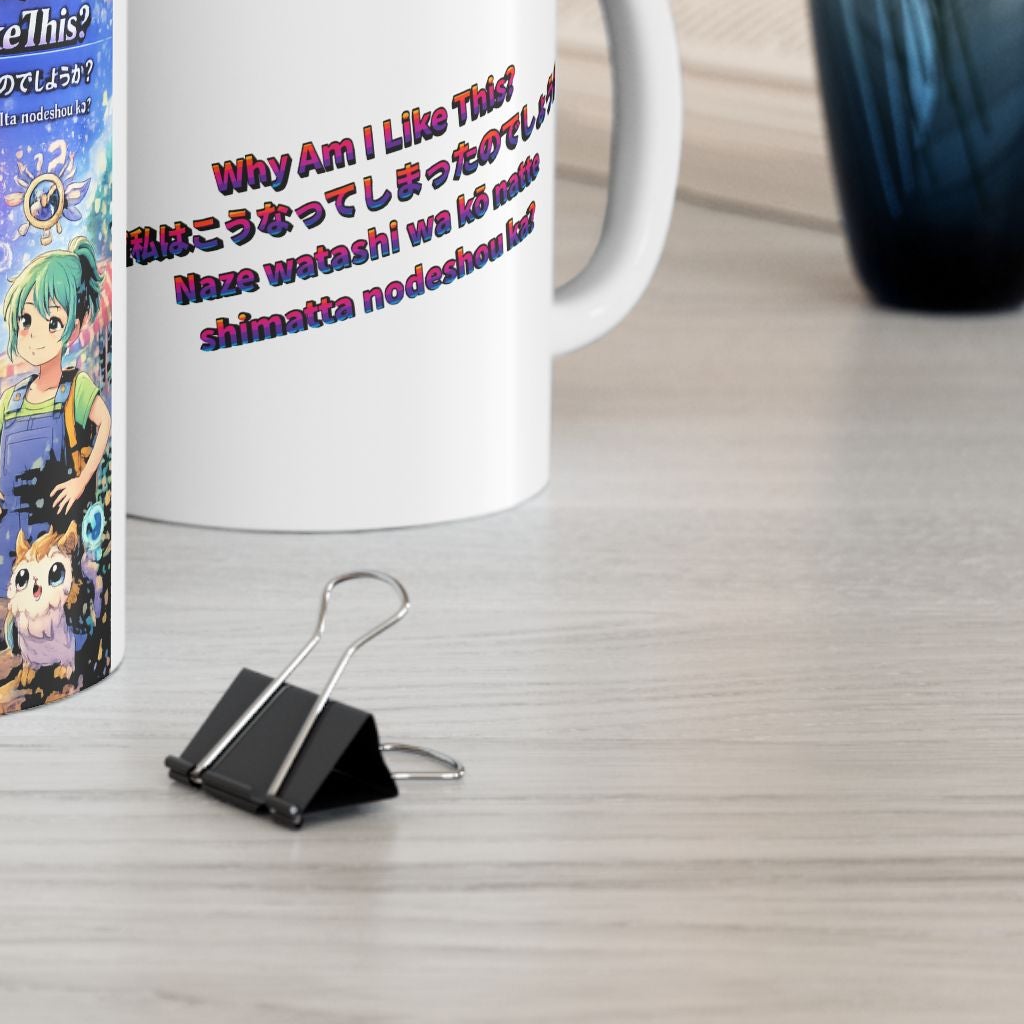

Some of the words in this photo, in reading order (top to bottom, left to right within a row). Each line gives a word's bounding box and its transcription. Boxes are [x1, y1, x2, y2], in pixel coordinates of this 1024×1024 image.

[18, 4, 91, 49] This?
[21, 104, 74, 124] nodeshou
[126, 62, 556, 267] 私はこうなってしまったのでしょう
[212, 152, 292, 196] Why
[297, 136, 356, 178] Am
[363, 125, 376, 160] I
[382, 105, 449, 154] Like
[452, 64, 516, 128] This?
[174, 263, 260, 305] Naze
[263, 220, 401, 287] watashi
[407, 210, 452, 247] wa
[457, 184, 490, 230] kō
[493, 152, 541, 210] natte
[199, 293, 356, 352] shimatta
[362, 239, 505, 314] nodeshou
[506, 201, 537, 252] ka?
